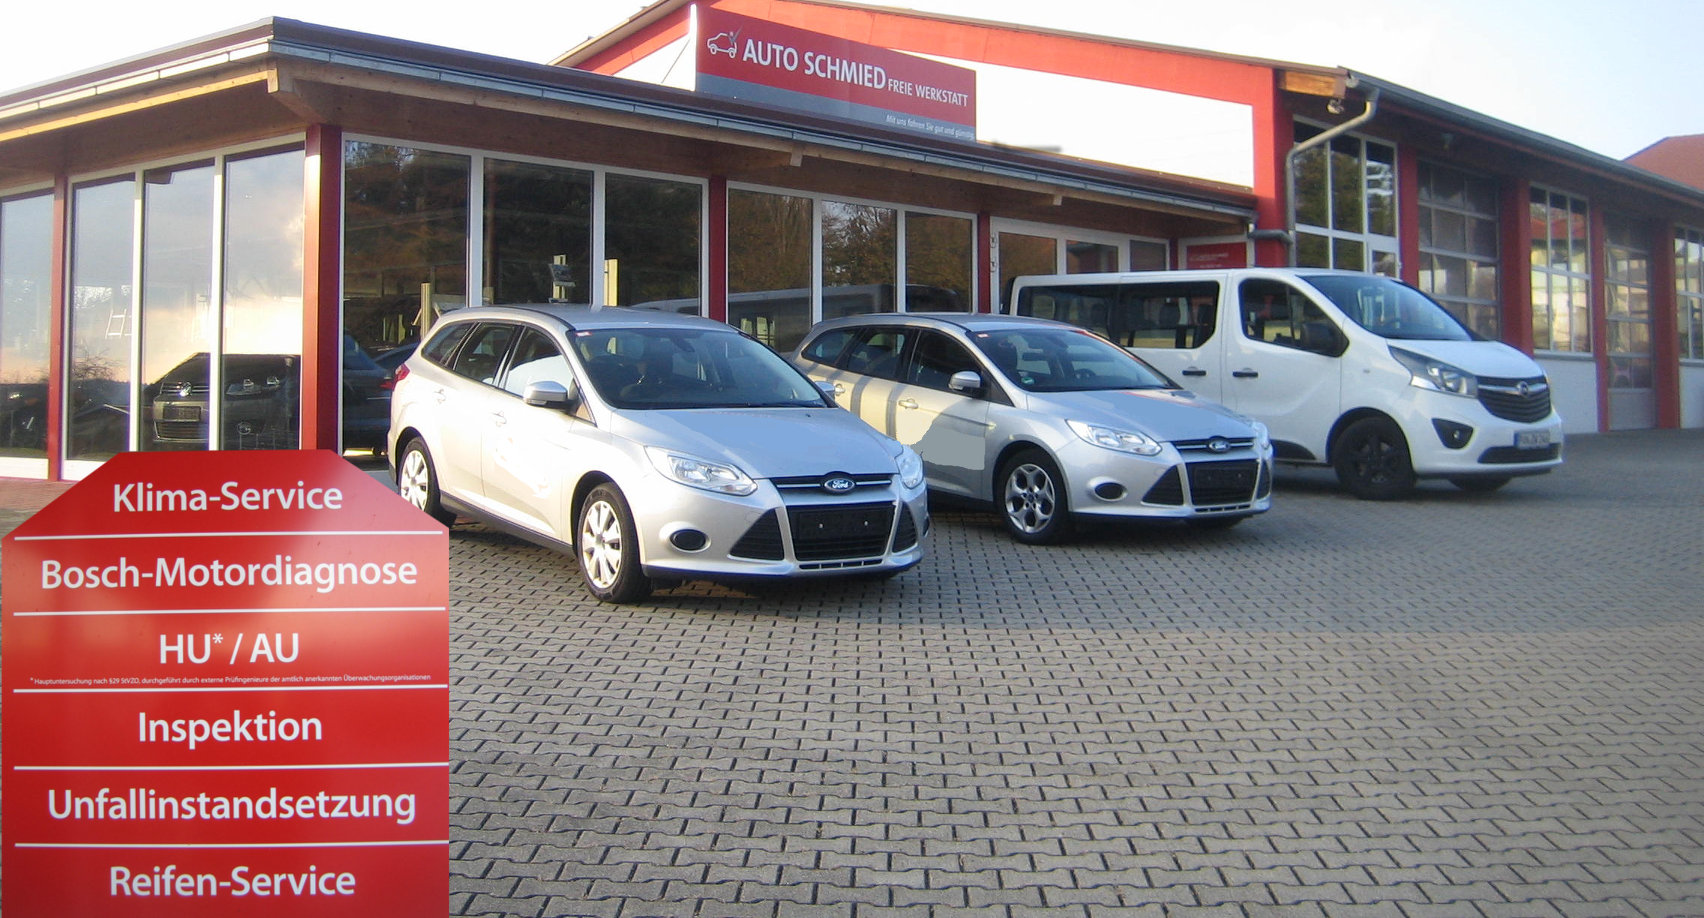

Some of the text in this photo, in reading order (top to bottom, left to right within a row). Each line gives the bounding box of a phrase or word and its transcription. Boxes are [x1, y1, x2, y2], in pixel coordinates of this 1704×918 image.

[743, 39, 968, 107] AUTO SCHMIED FREIE WERKSTATT
[113, 480, 343, 512] Klima-Service
[41, 555, 418, 594] Bosch-Motordiagnose
[229, 633, 243, 664] /
[249, 632, 300, 662] AU
[34, 678, 92, 686] Hauptuntersuchung
[142, 677, 180, 685] durchgeführt
[225, 675, 268, 684] Prüfingenieure
[305, 674, 342, 682] anerkannten
[343, 673, 431, 682] Überwachungsorganisationen
[139, 710, 323, 749] Inspektion
[48, 788, 416, 825] Unfallinstandsetzung
[110, 865, 356, 896] Reifen-Service
